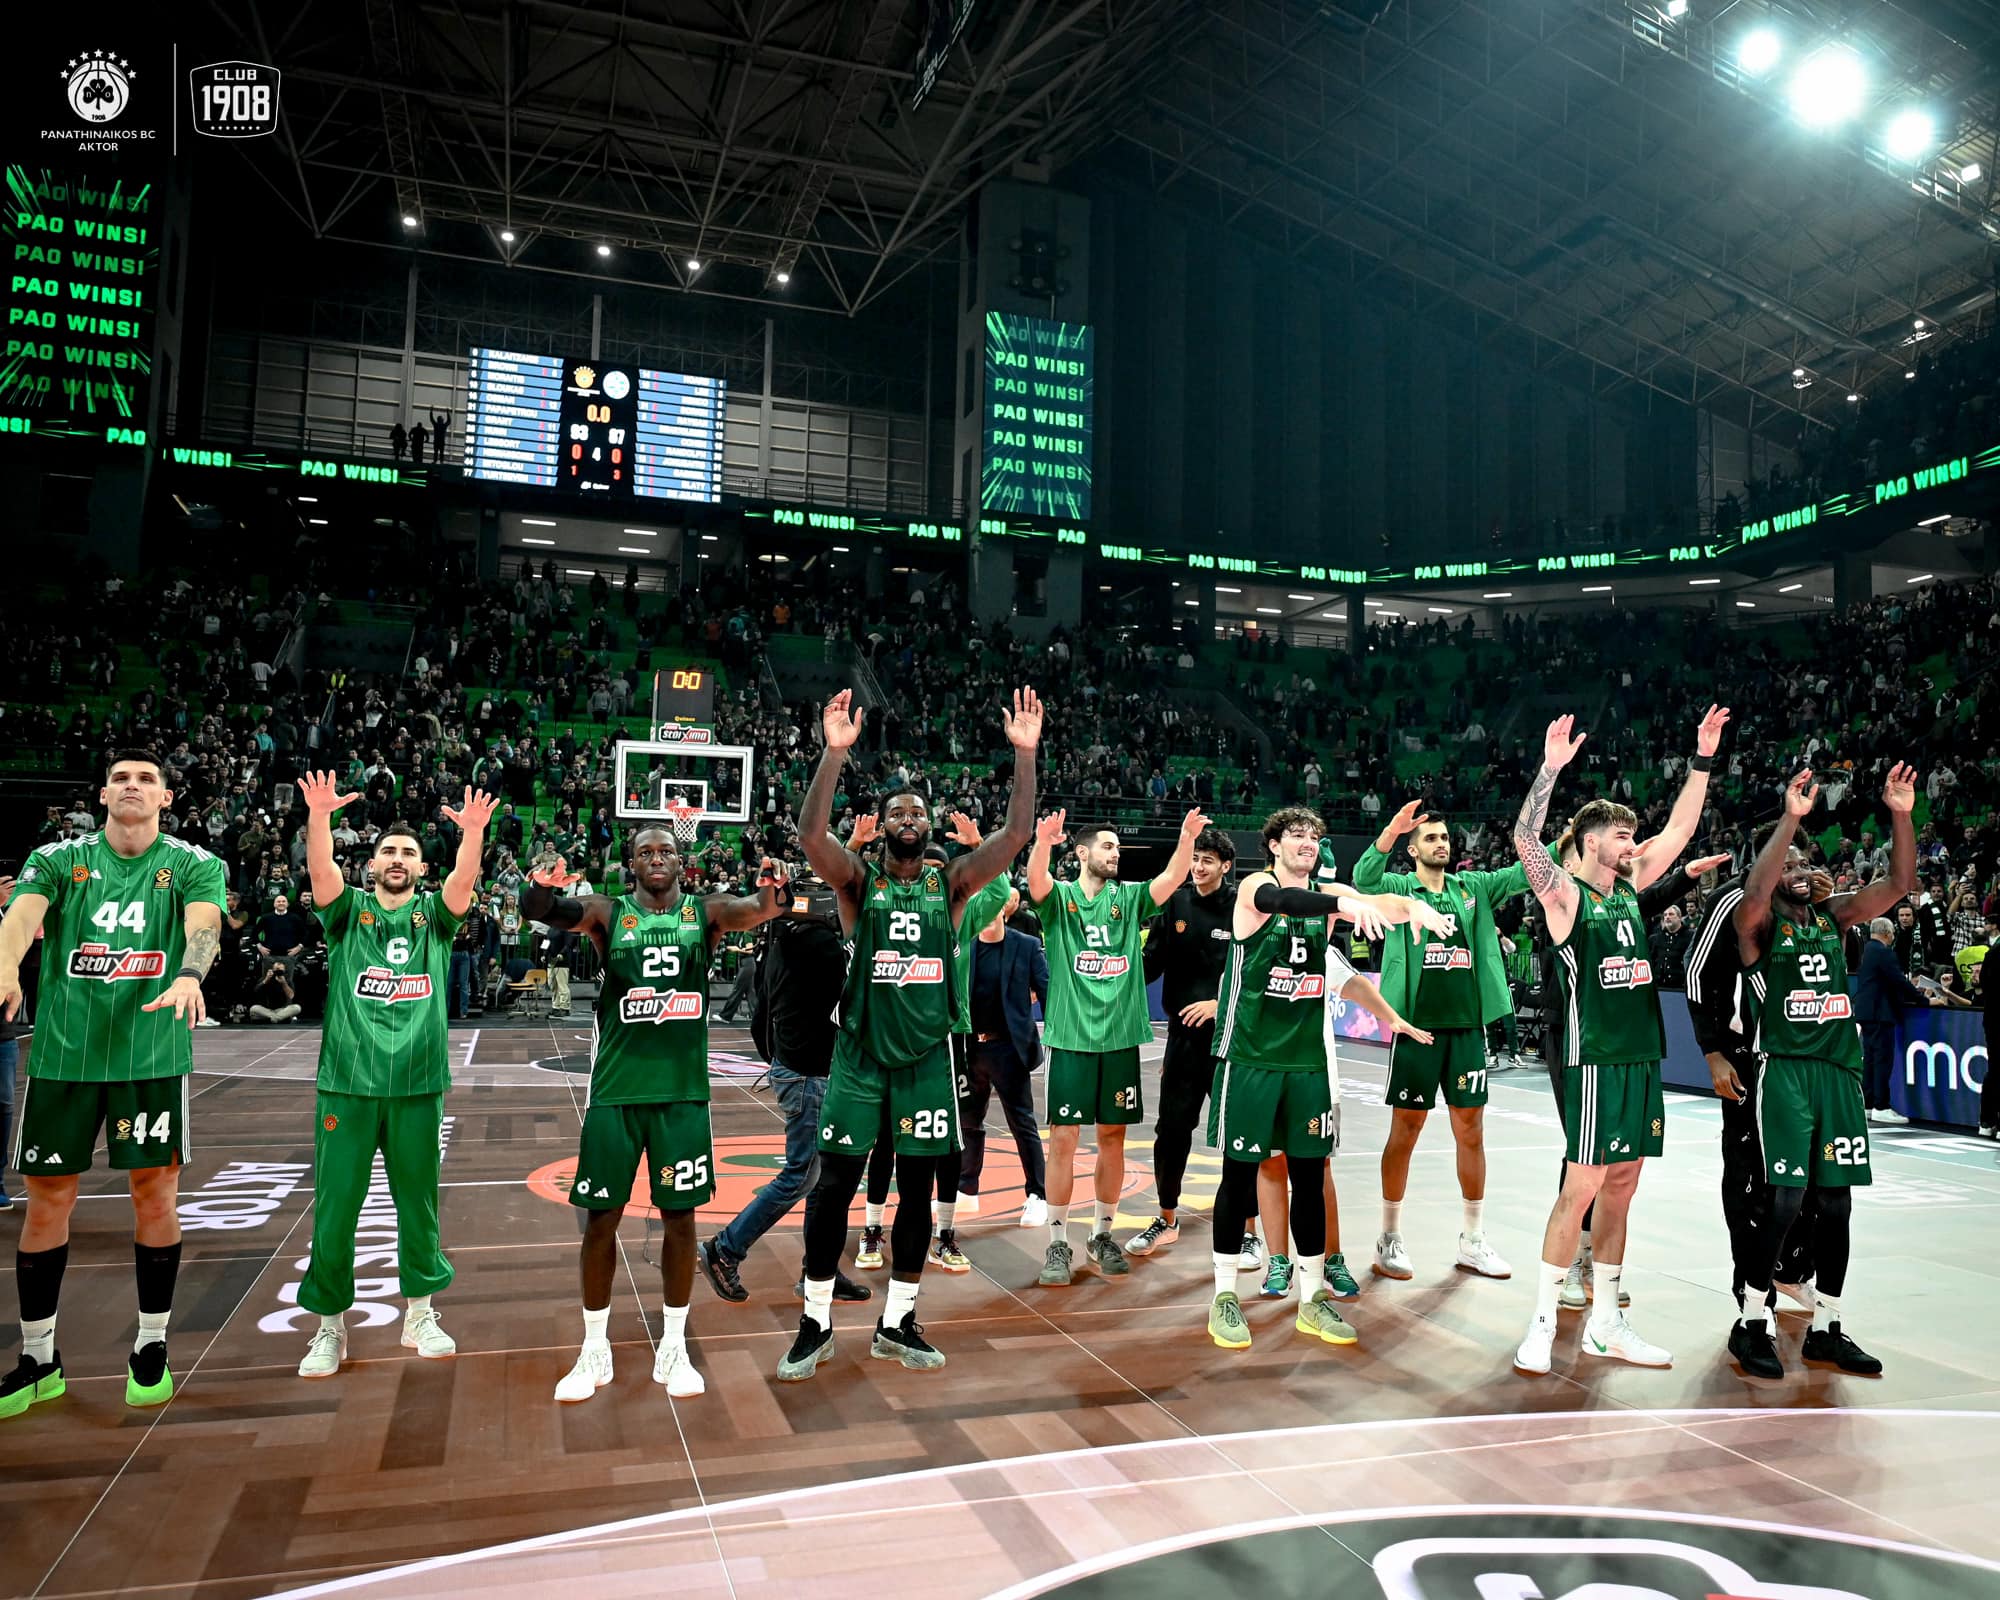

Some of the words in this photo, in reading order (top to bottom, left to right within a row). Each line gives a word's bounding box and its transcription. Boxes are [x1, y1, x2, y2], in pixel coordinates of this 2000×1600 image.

[17, 212, 64, 233] PAO
[74, 219, 147, 245] WINS!
[14, 244, 62, 265] PAO
[72, 251, 144, 276] WINS!
[12, 276, 59, 297] PAO
[69, 282, 142, 307] WINS!
[9, 308, 56, 328] PAO
[67, 314, 139, 338] WINS!
[6, 340, 54, 360] PAO
[64, 346, 137, 370] WINS!
[995, 351, 1028, 368] PAO
[1034, 356, 1084, 376] WINS!
[994, 378, 1027, 394] PAO
[1034, 382, 1083, 401] WINS!
[587, 404, 610, 423] 0.0
[994, 404, 1026, 420] PAO
[1033, 408, 1083, 428] WINS!
[107, 427, 146, 445] PAO
[993, 430, 1026, 447] PAO
[1032, 435, 1083, 454] WINS!
[173, 448, 232, 467] WINS!
[571, 444, 582, 460] 0
[592, 447, 601, 461] 4
[611, 448, 622, 464] 0
[301, 461, 337, 477] PAO
[344, 465, 399, 484] WINS!
[571, 465, 577, 476] 1
[993, 457, 1025, 474] PAO
[1032, 461, 1082, 480] WINS!
[1875, 478, 1908, 504] PAO
[1914, 457, 1968, 491] WINS!
[774, 510, 804, 525] PAO
[809, 513, 855, 530] WINS!
[909, 524, 937, 539] PAO
[1742, 520, 1768, 544] PAO
[1773, 504, 1817, 533] WINS!
[1058, 529, 1086, 544] PAO
[1101, 544, 1142, 561] WINS!
[1189, 554, 1215, 569] PAO
[1218, 557, 1257, 573] WINS!
[1538, 557, 1566, 572] PAO
[1571, 553, 1615, 569] WINS!
[1670, 547, 1699, 561] PAO
[1301, 566, 1326, 580] PAO
[1329, 568, 1367, 583] WINS!
[1415, 565, 1441, 580] PAO
[1446, 562, 1487, 578] WINS!
[1123, 827, 1139, 835] EXIT
[91, 901, 146, 933] 44
[889, 911, 921, 941] 26
[1085, 925, 1112, 947] 21
[1617, 919, 1636, 947] 41
[386, 936, 409, 964] 6
[642, 946, 680, 977] 25
[1798, 953, 1831, 982] 22
[1467, 1069, 1486, 1094] 77
[132, 1111, 170, 1144] 44
[914, 1109, 948, 1139] 26
[1320, 1112, 1333, 1139] 16
[1834, 1136, 1867, 1165] 22
[675, 1155, 708, 1191] 25
[176, 1162, 312, 1231] AKTOR
